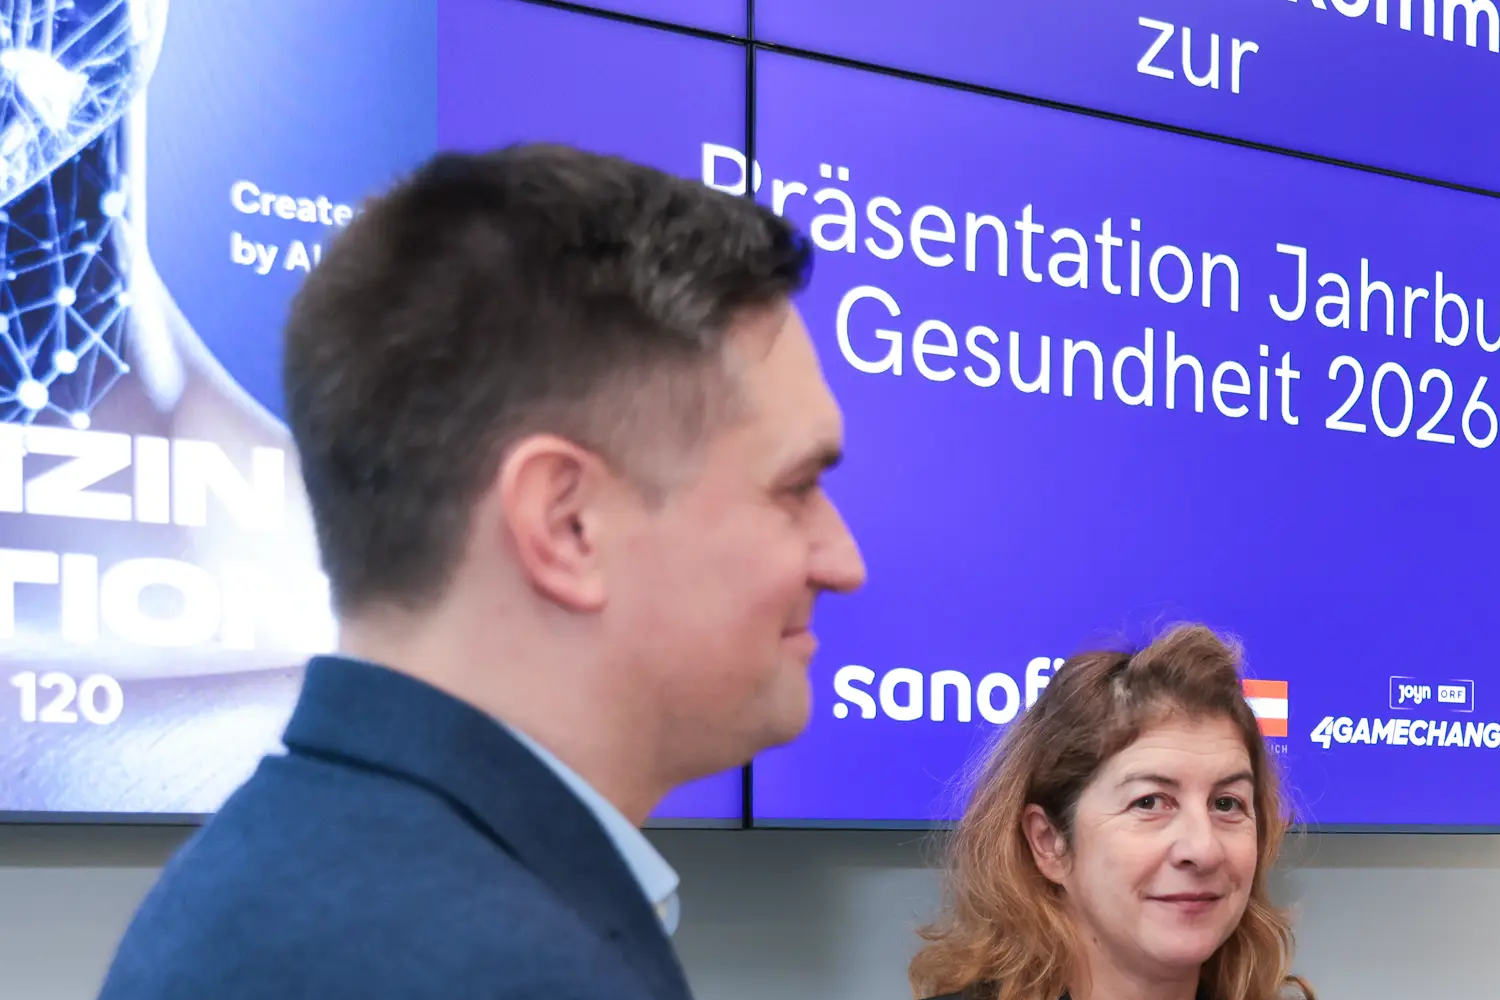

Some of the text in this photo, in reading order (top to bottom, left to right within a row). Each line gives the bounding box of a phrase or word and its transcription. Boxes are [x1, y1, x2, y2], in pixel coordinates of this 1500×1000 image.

[1137, 17, 1260, 94] zur
[230, 179, 366, 227] Create
[702, 142, 1240, 313] Präsentation
[230, 231, 278, 275] by
[835, 286, 1499, 450] Gesundheit 2026
[10, 671, 124, 725] 120
[833, 656, 1066, 725] sanof
[1398, 684, 1464, 705] joyn ORF
